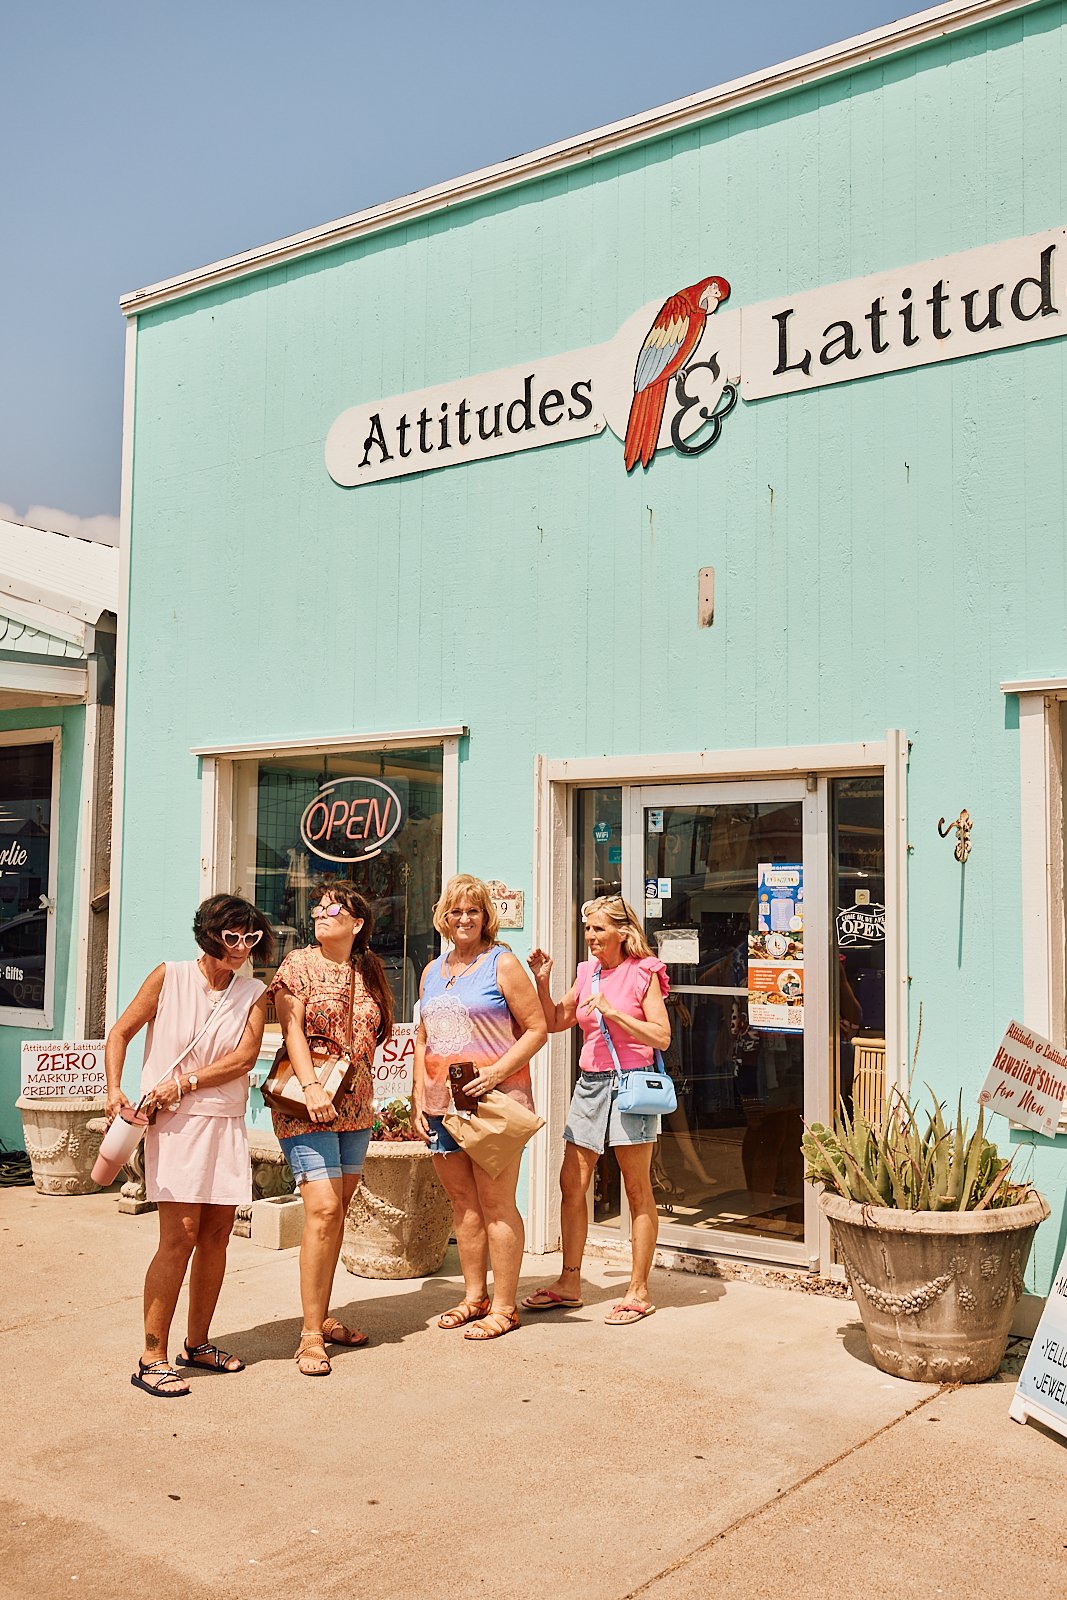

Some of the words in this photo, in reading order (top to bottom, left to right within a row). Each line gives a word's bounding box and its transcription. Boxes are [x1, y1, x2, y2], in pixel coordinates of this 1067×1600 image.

[357, 373, 594, 467] Attitudes
[670, 353, 738, 456] &
[771, 244, 1059, 377] Latitud
[306, 796, 392, 841] OPEN
[5, 966, 24, 981] Gifts
[22, 1043, 61, 1052] Attitudes
[63, 1042, 71, 1051] &
[1005, 1022, 1035, 1050] Attitudes
[1035, 1043, 1043, 1054] &
[27, 1073, 79, 1083] MARKUP
[81, 1072, 105, 1083] FOR
[36, 1052, 97, 1072] ZERO
[992, 1046, 1037, 1087] Hawaiian
[1036, 1069, 1067, 1102] Shirts
[22, 1086, 66, 1096] CREDIT
[68, 1084, 109, 1095] CARDS
[992, 1080, 1015, 1099] for
[1017, 1089, 1046, 1117] Men
[1035, 1372, 1067, 1406] JEWEL
